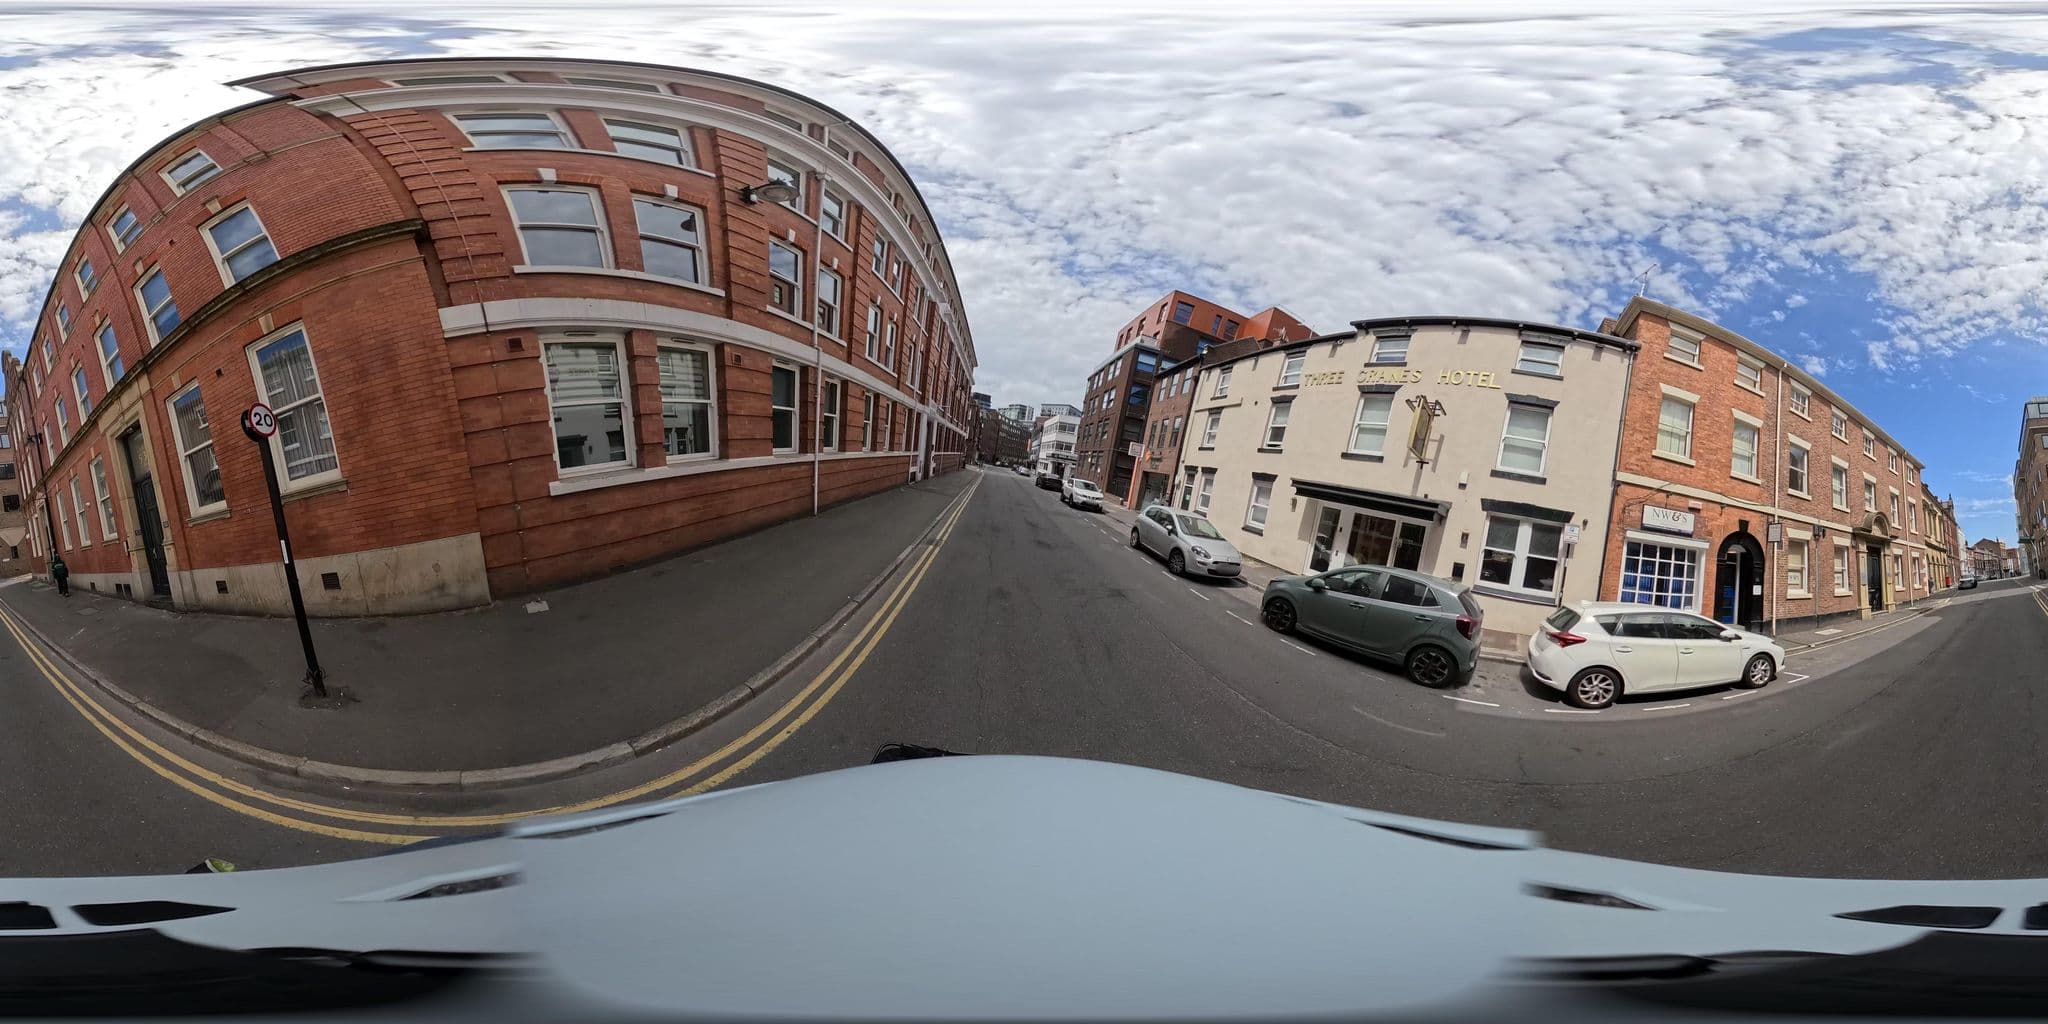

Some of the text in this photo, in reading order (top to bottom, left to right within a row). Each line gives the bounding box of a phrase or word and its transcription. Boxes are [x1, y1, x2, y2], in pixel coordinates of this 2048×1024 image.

[1304, 369, 1501, 389] THREE CRANES HOTEL
[253, 412, 273, 427] 20
